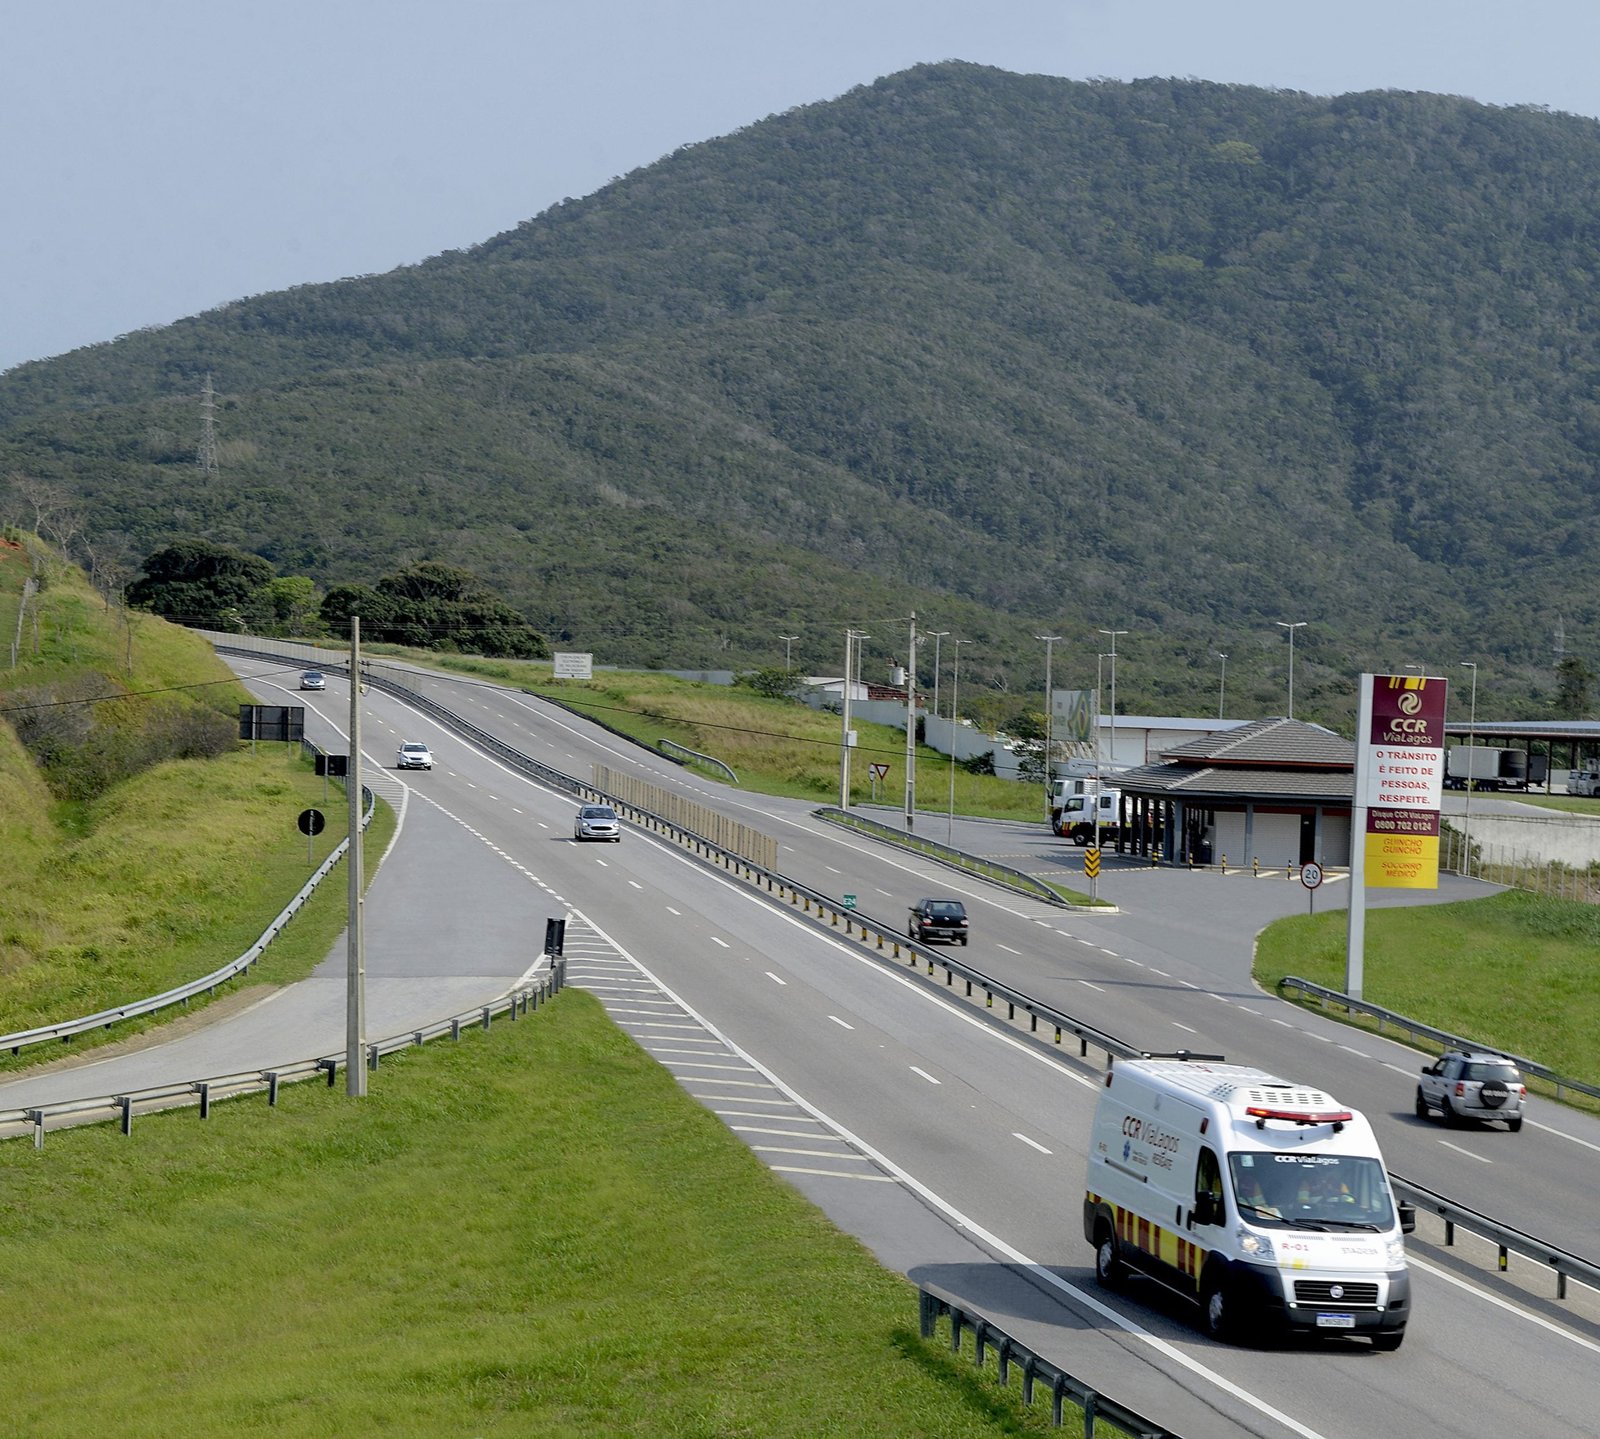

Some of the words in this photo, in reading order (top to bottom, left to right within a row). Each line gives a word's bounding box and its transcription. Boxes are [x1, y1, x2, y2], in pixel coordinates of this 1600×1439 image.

[1391, 718, 1427, 733] CCR
[1383, 732, 1433, 745] ViaLagos
[1379, 764, 1385, 773] É
[1389, 766, 1418, 774] FEITO
[1381, 780, 1430, 790] PESSOAS,
[1379, 794, 1430, 804] RESPEITE.
[1394, 811, 1409, 819] CCR
[1375, 820, 1395, 829] 0800
[1383, 838, 1423, 847] GUINCHO
[1382, 845, 1422, 855] GUINCHO
[1305, 869, 1318, 880] 20
[1122, 1115, 1142, 1140] CCR
